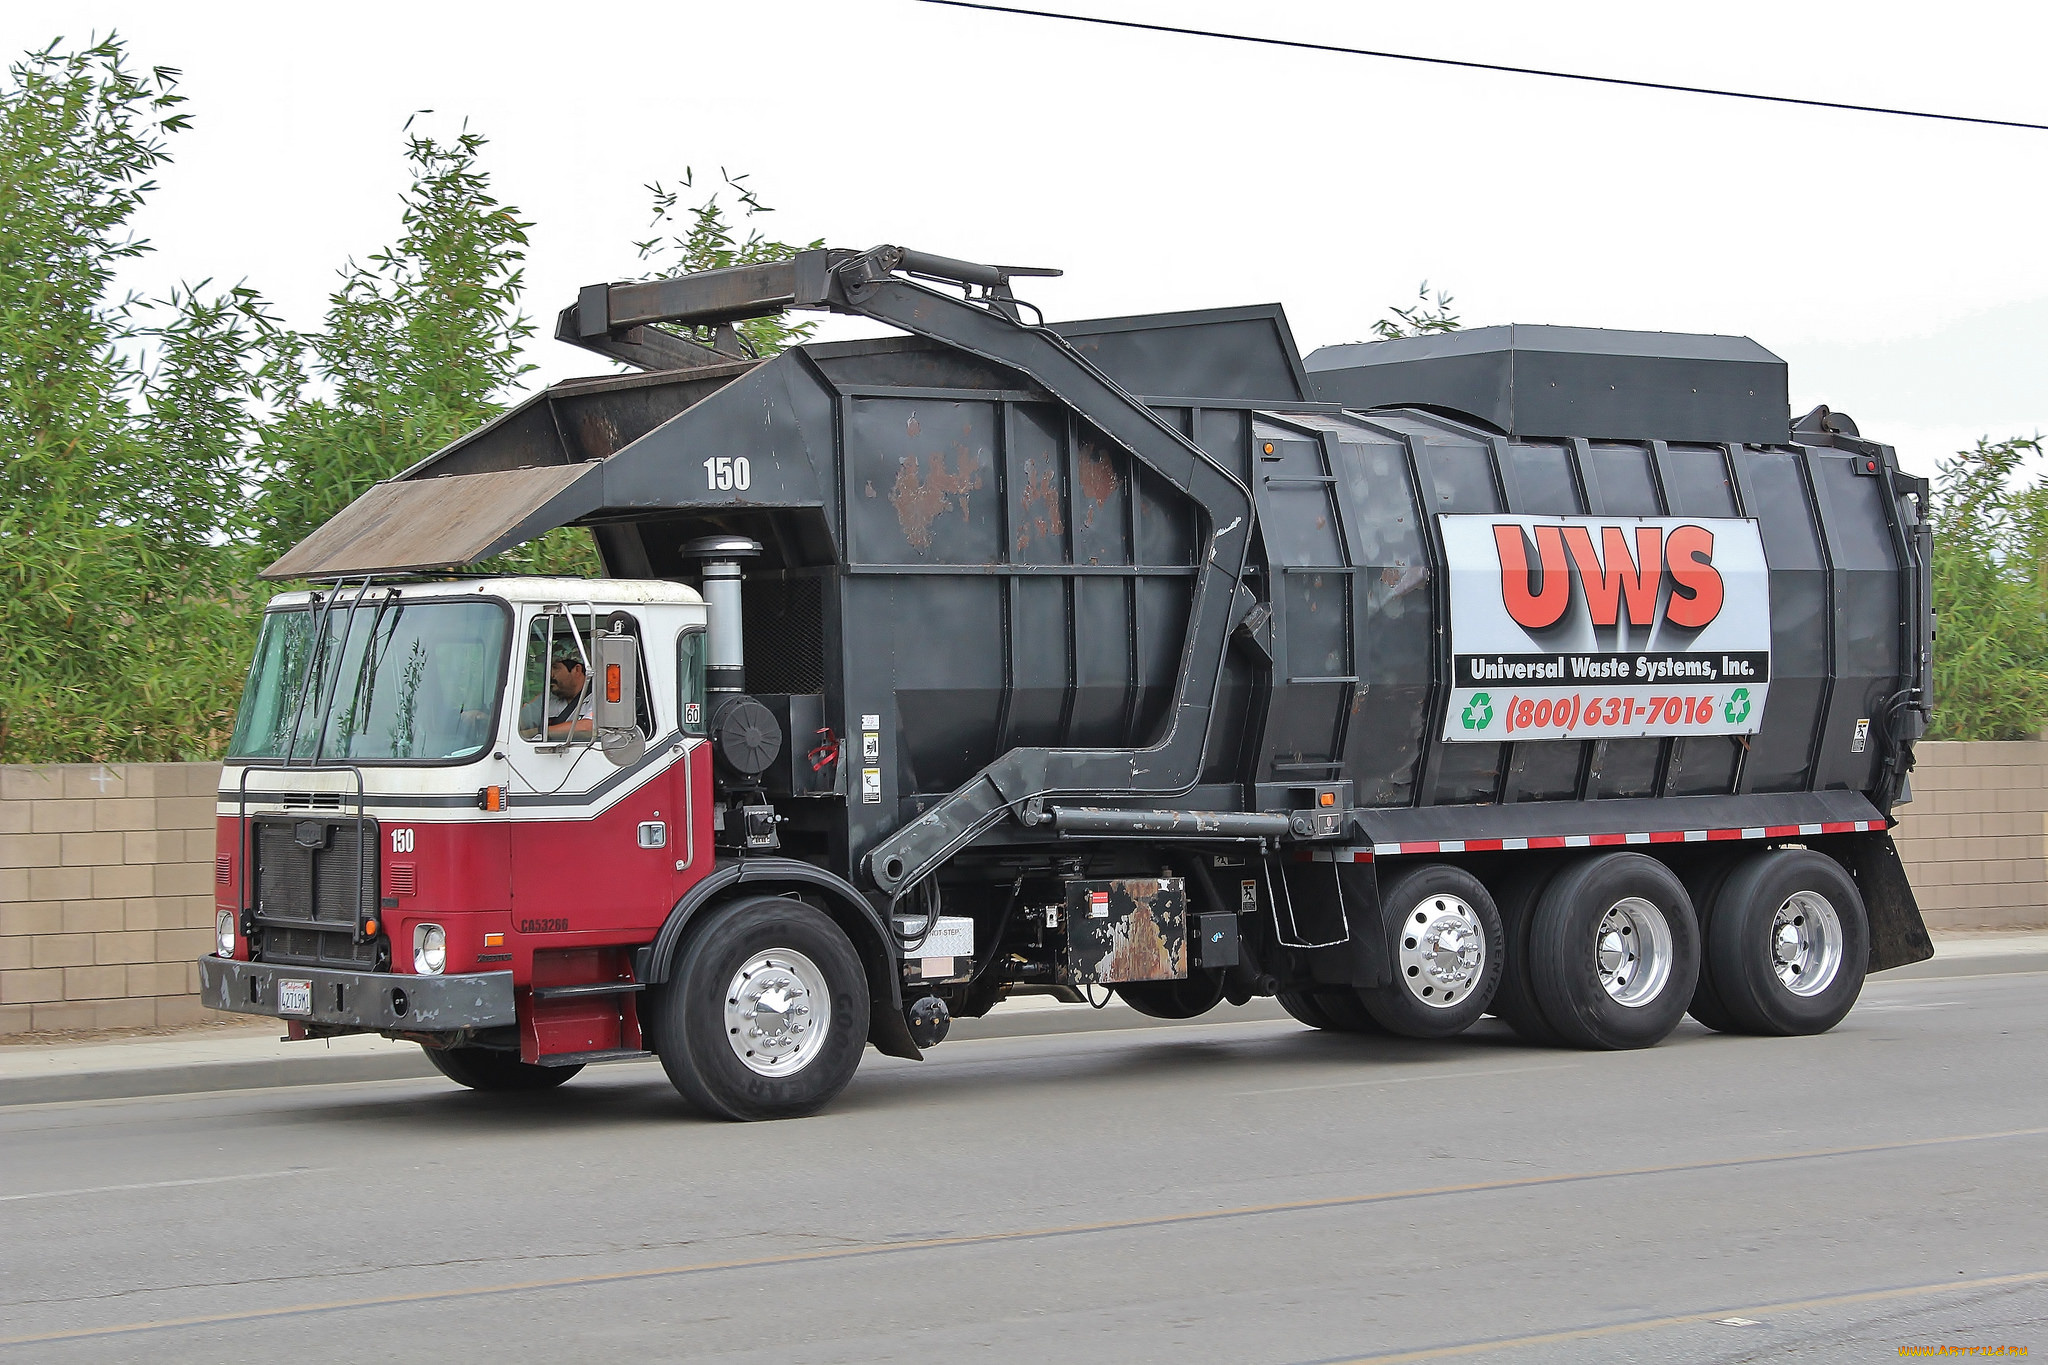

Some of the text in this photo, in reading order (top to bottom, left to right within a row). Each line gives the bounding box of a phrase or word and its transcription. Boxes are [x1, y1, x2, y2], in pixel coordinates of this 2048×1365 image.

[703, 456, 751, 491] 150
[1492, 524, 1725, 629] UWS
[1470, 655, 1755, 682] Universal Waste Systems, Inc.
[686, 708, 699, 722] 60
[390, 828, 415, 853] 150
[943, 928, 960, 936] STEP
